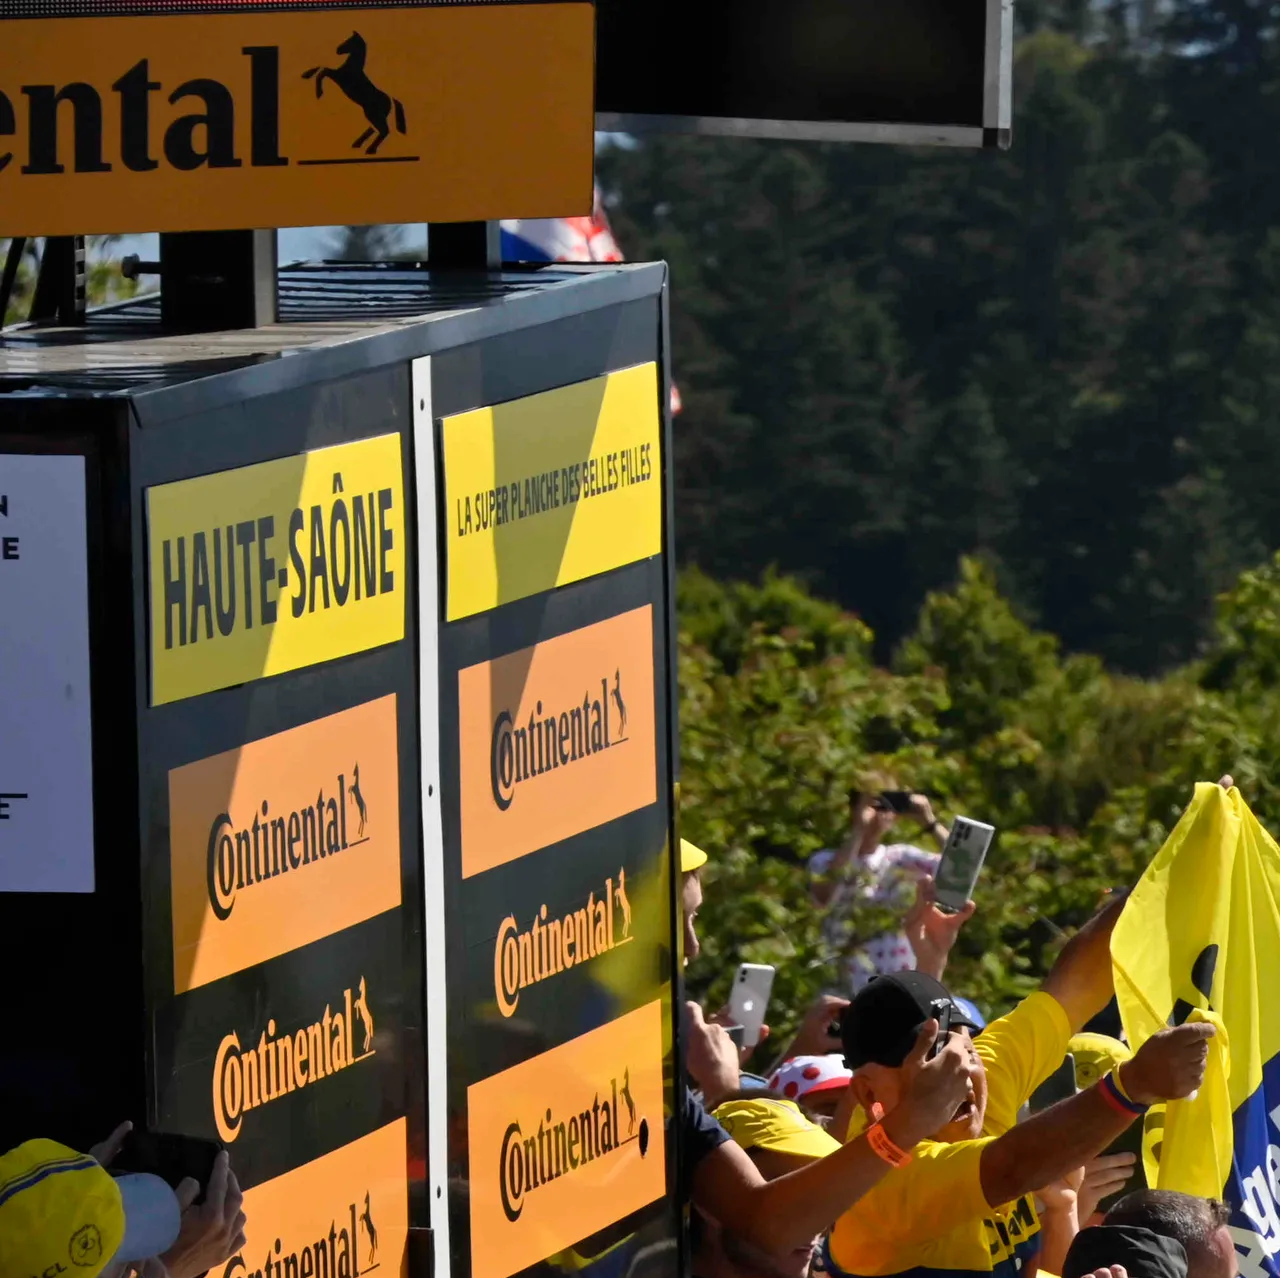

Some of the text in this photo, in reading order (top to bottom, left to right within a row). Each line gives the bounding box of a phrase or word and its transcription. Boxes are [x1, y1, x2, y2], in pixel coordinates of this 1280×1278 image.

[457, 442, 651, 537] LA SUPER PLANCHE DES BELLES FILLES
[163, 473, 395, 651] HAUTE-SAÔNE
[490, 678, 611, 812] Continental
[206, 773, 350, 921] Continental
[493, 880, 615, 1018] Continental
[212, 988, 355, 1143] Continental
[500, 1079, 622, 1222] Continental
